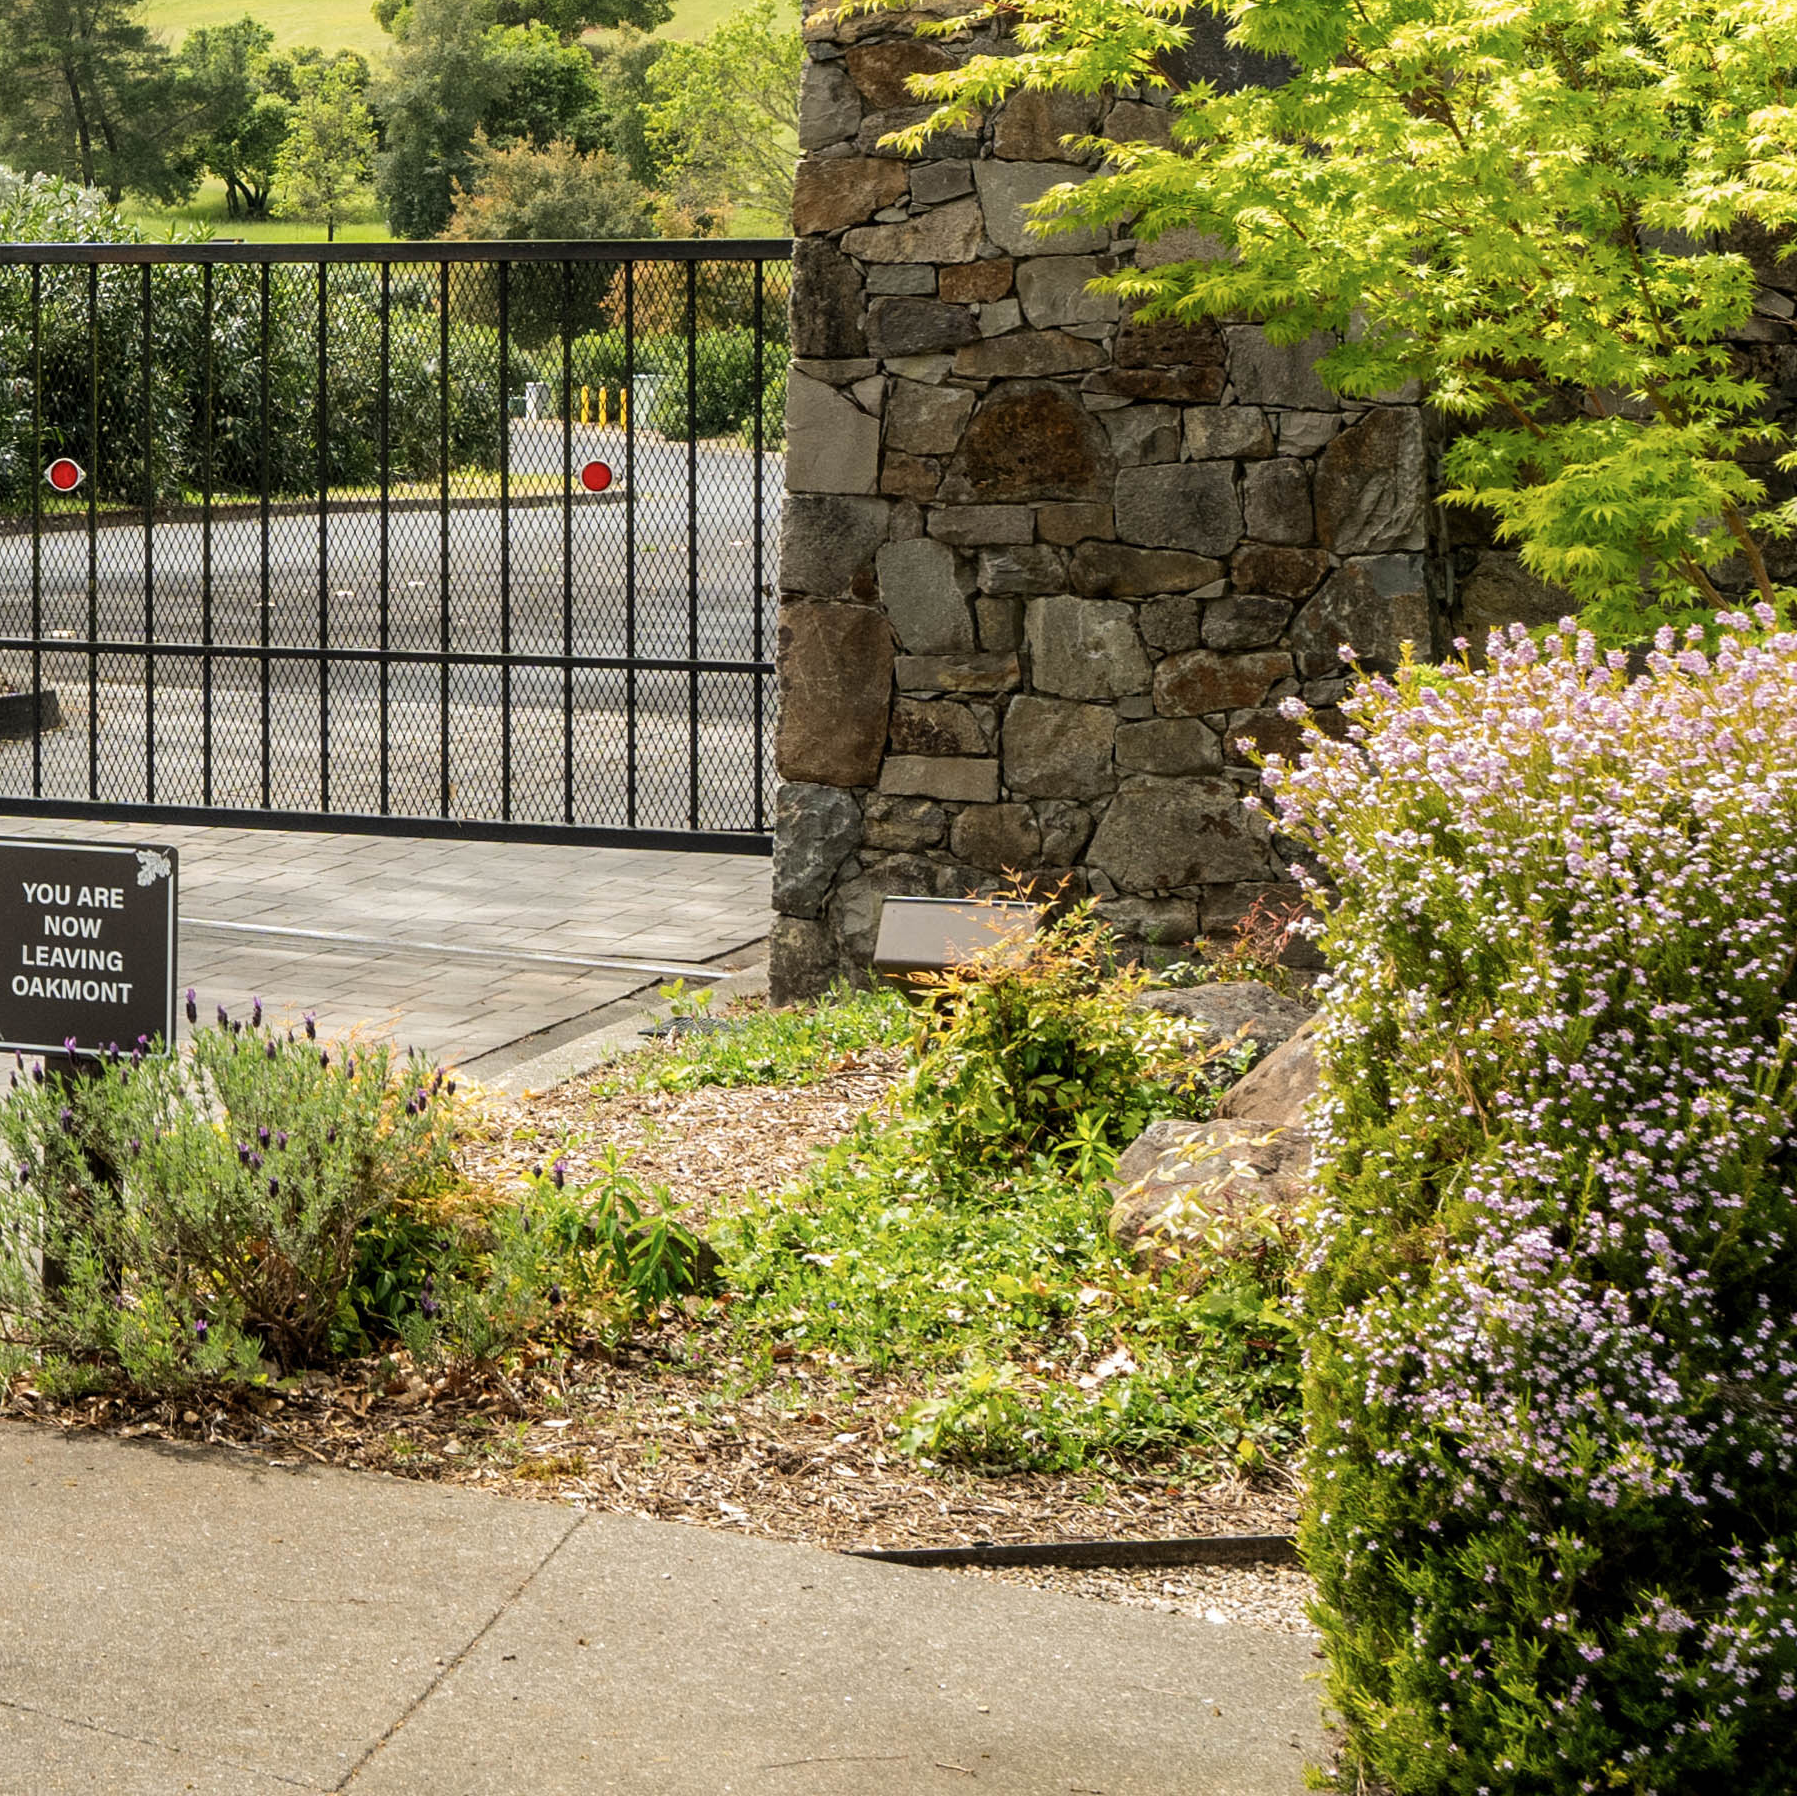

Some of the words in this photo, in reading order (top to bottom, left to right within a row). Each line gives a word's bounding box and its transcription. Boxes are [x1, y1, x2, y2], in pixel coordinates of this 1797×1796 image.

[22, 882, 71, 905] YOU
[76, 885, 125, 910] ARE
[44, 915, 102, 940] NOW
[21, 944, 124, 973] LEAVING
[11, 974, 133, 1005] OAKMONT
